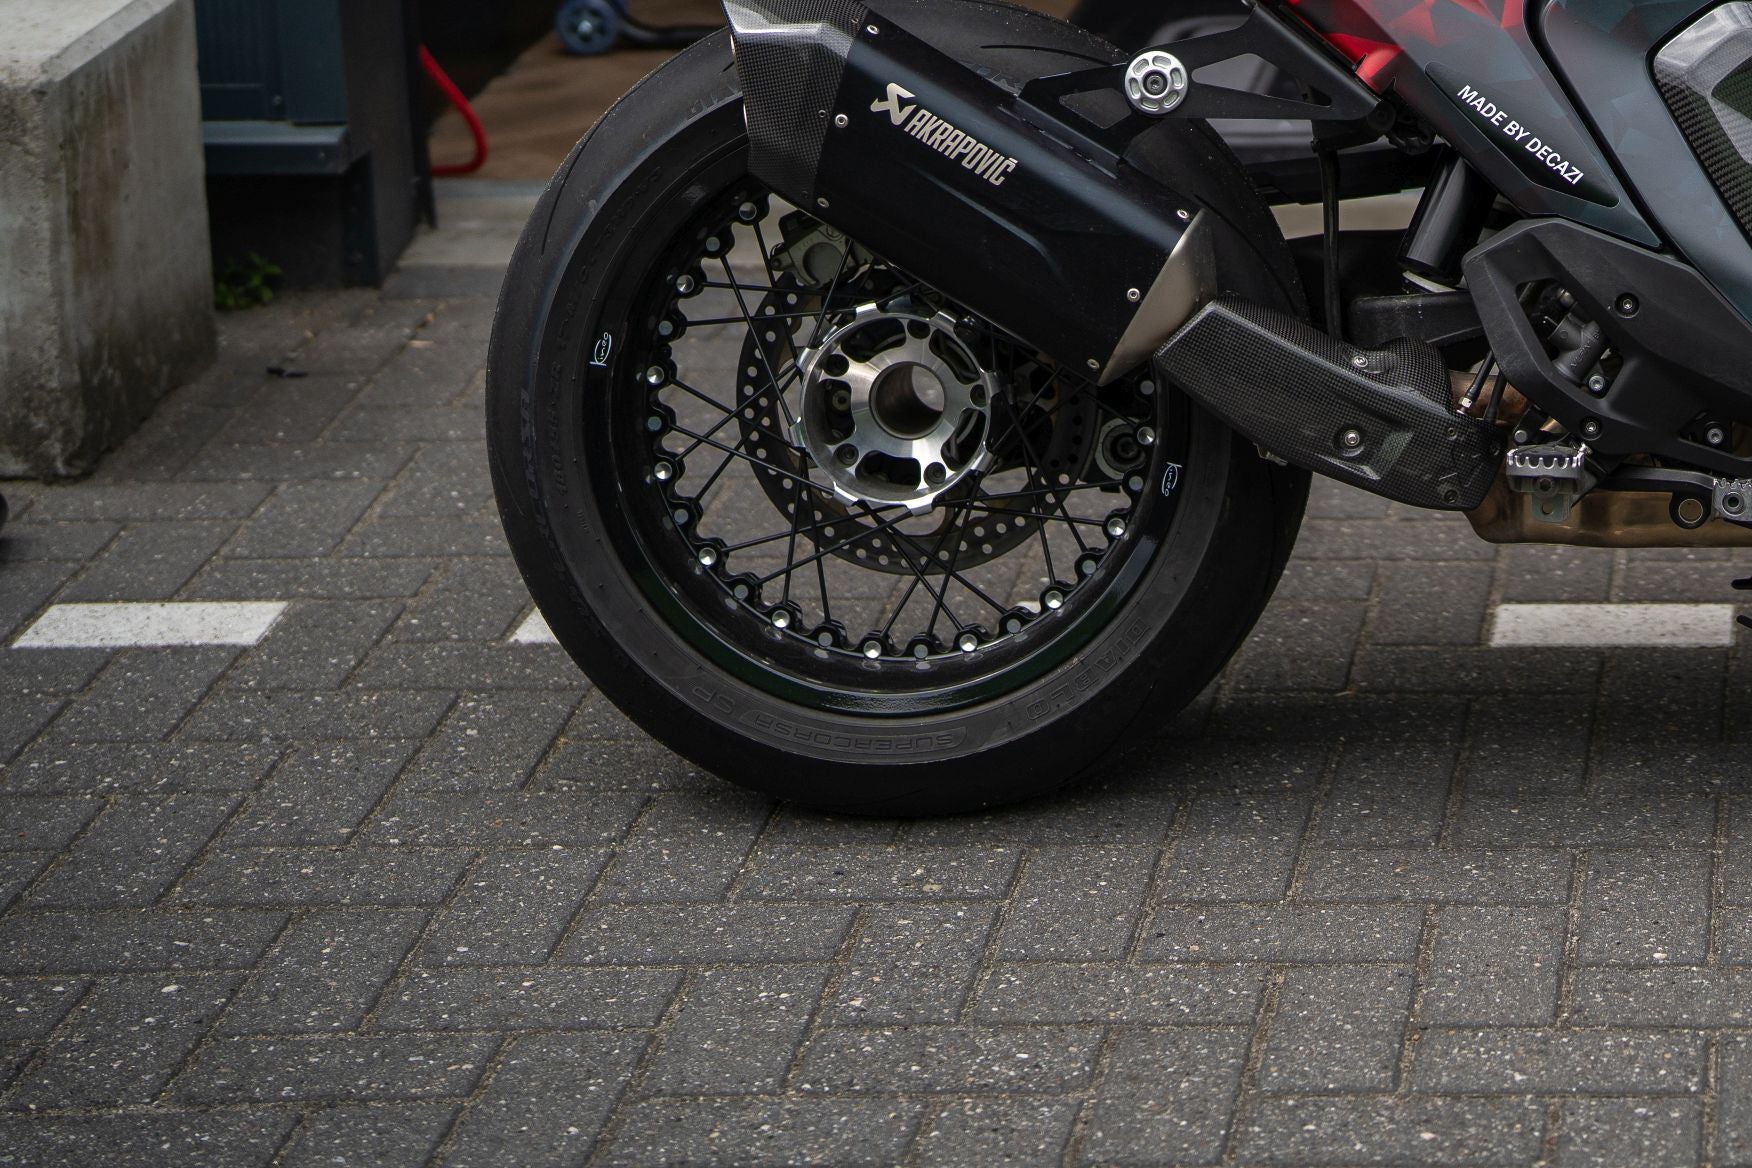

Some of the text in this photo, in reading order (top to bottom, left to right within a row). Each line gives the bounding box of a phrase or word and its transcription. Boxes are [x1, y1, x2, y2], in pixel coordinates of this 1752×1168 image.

[1457, 84, 1585, 185] MADE BY DECAZI
[691, 684, 955, 752] SUPERCORSA SP
[1026, 617, 1148, 720] DIABLO
